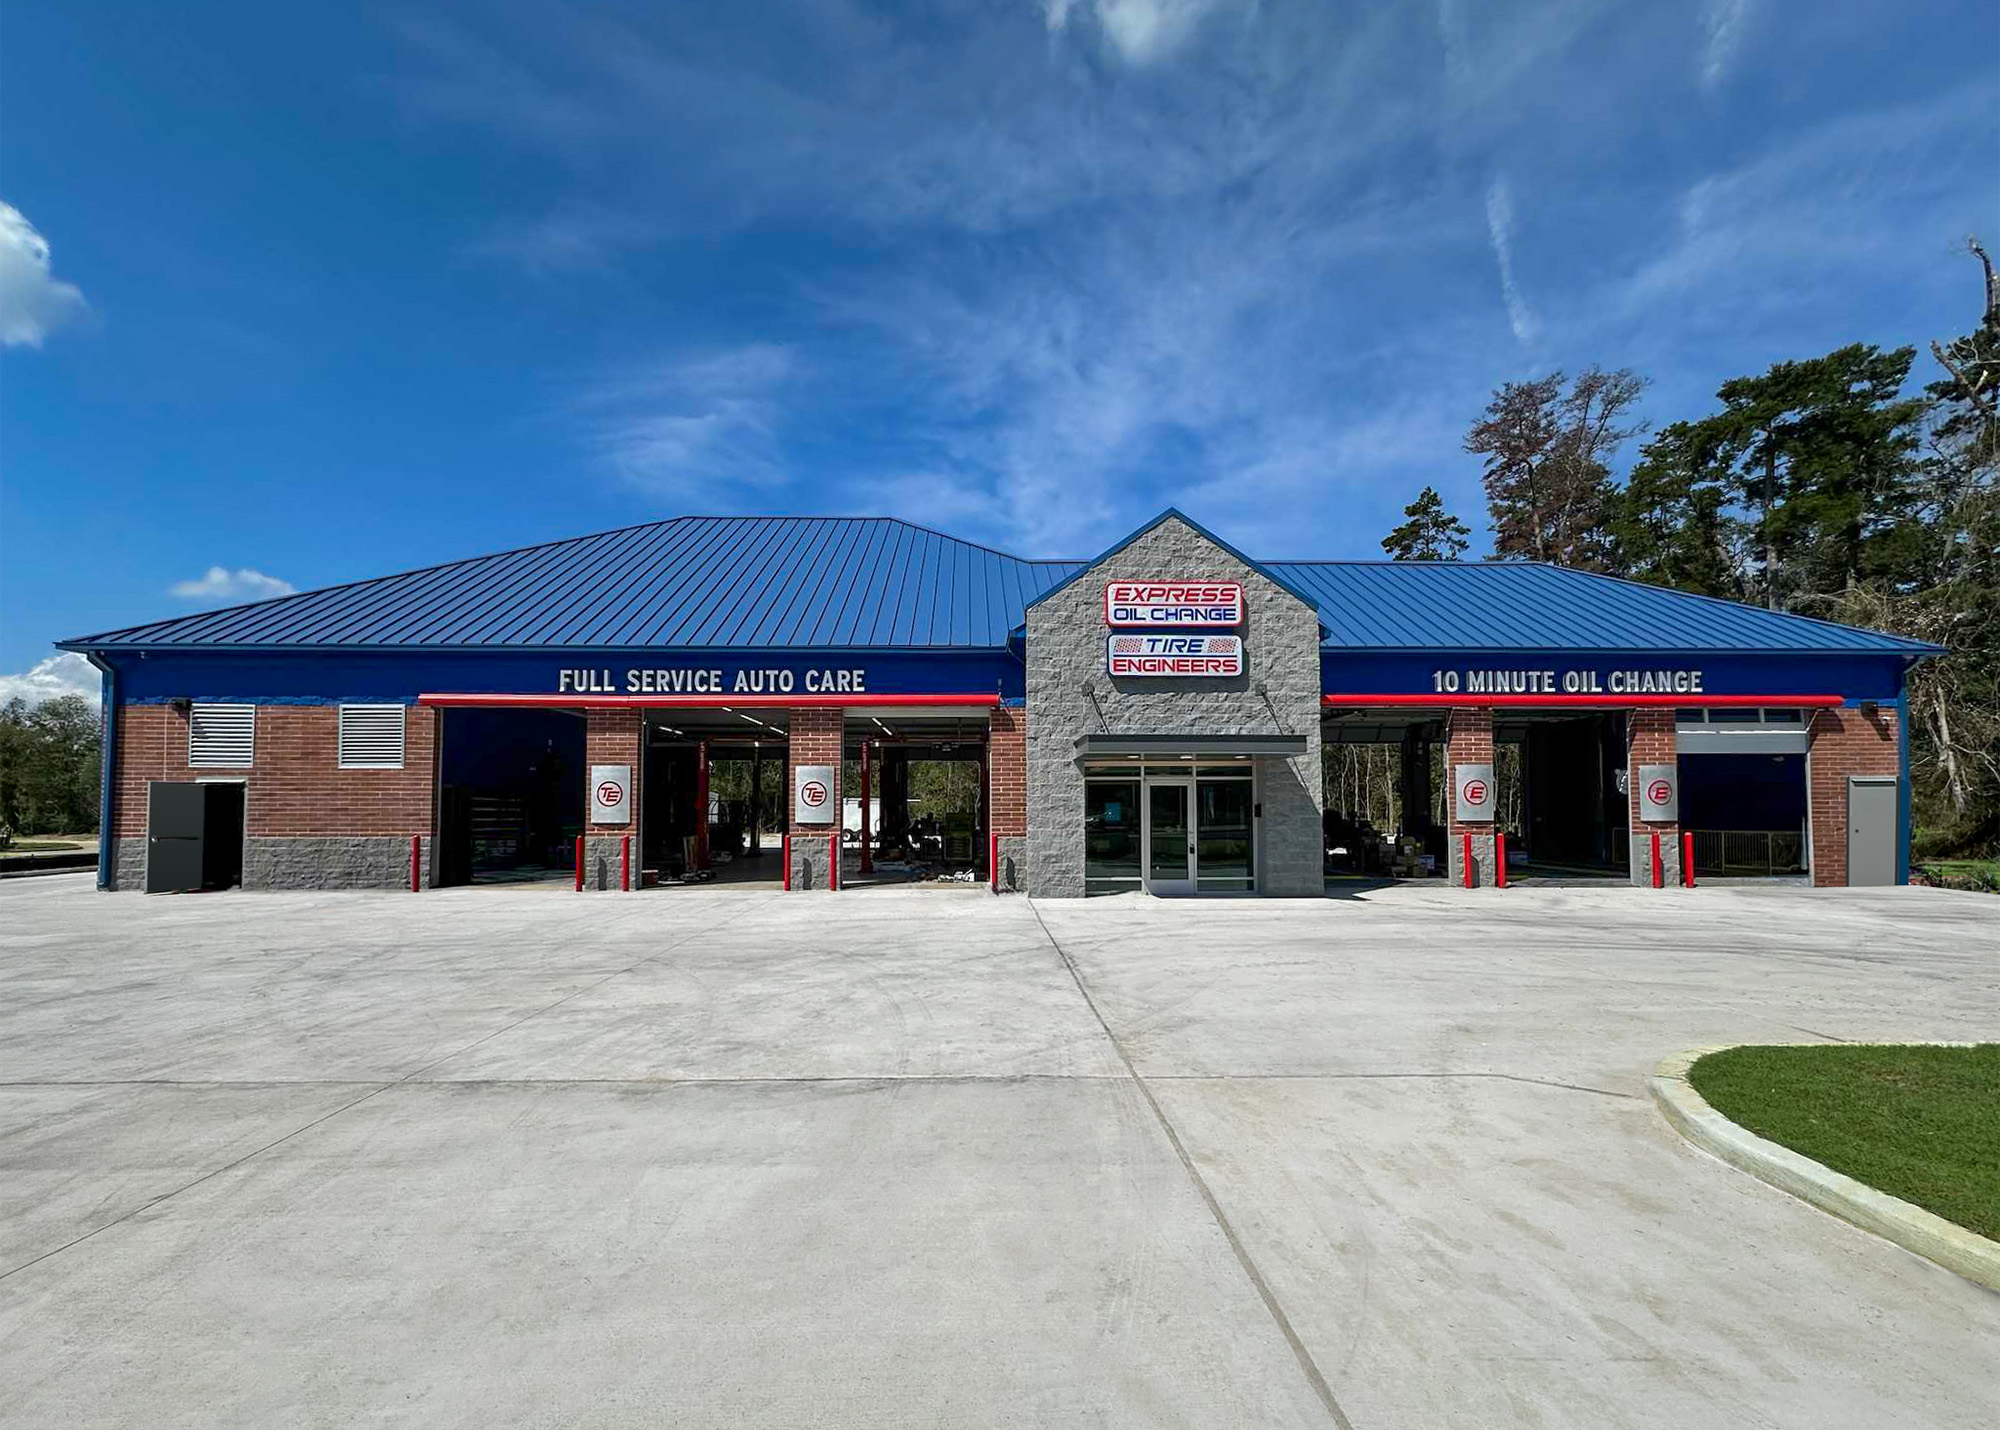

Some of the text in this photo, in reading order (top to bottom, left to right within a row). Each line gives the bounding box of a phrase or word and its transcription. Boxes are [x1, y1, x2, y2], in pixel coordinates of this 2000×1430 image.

[1113, 587, 1237, 602] EXPRESS
[1113, 608, 1237, 621] OIL CHANGE
[1146, 638, 1204, 653] TIRE
[1113, 659, 1238, 672] ENGINEERS
[558, 669, 865, 692] FULL SERVICE AUTO CARE
[1432, 670, 1703, 693] 10 MINUTE OIL CHANGE
[601, 787, 620, 802] TE
[805, 787, 824, 802] TE
[1469, 786, 1485, 799] E
[1654, 786, 1669, 800] E
